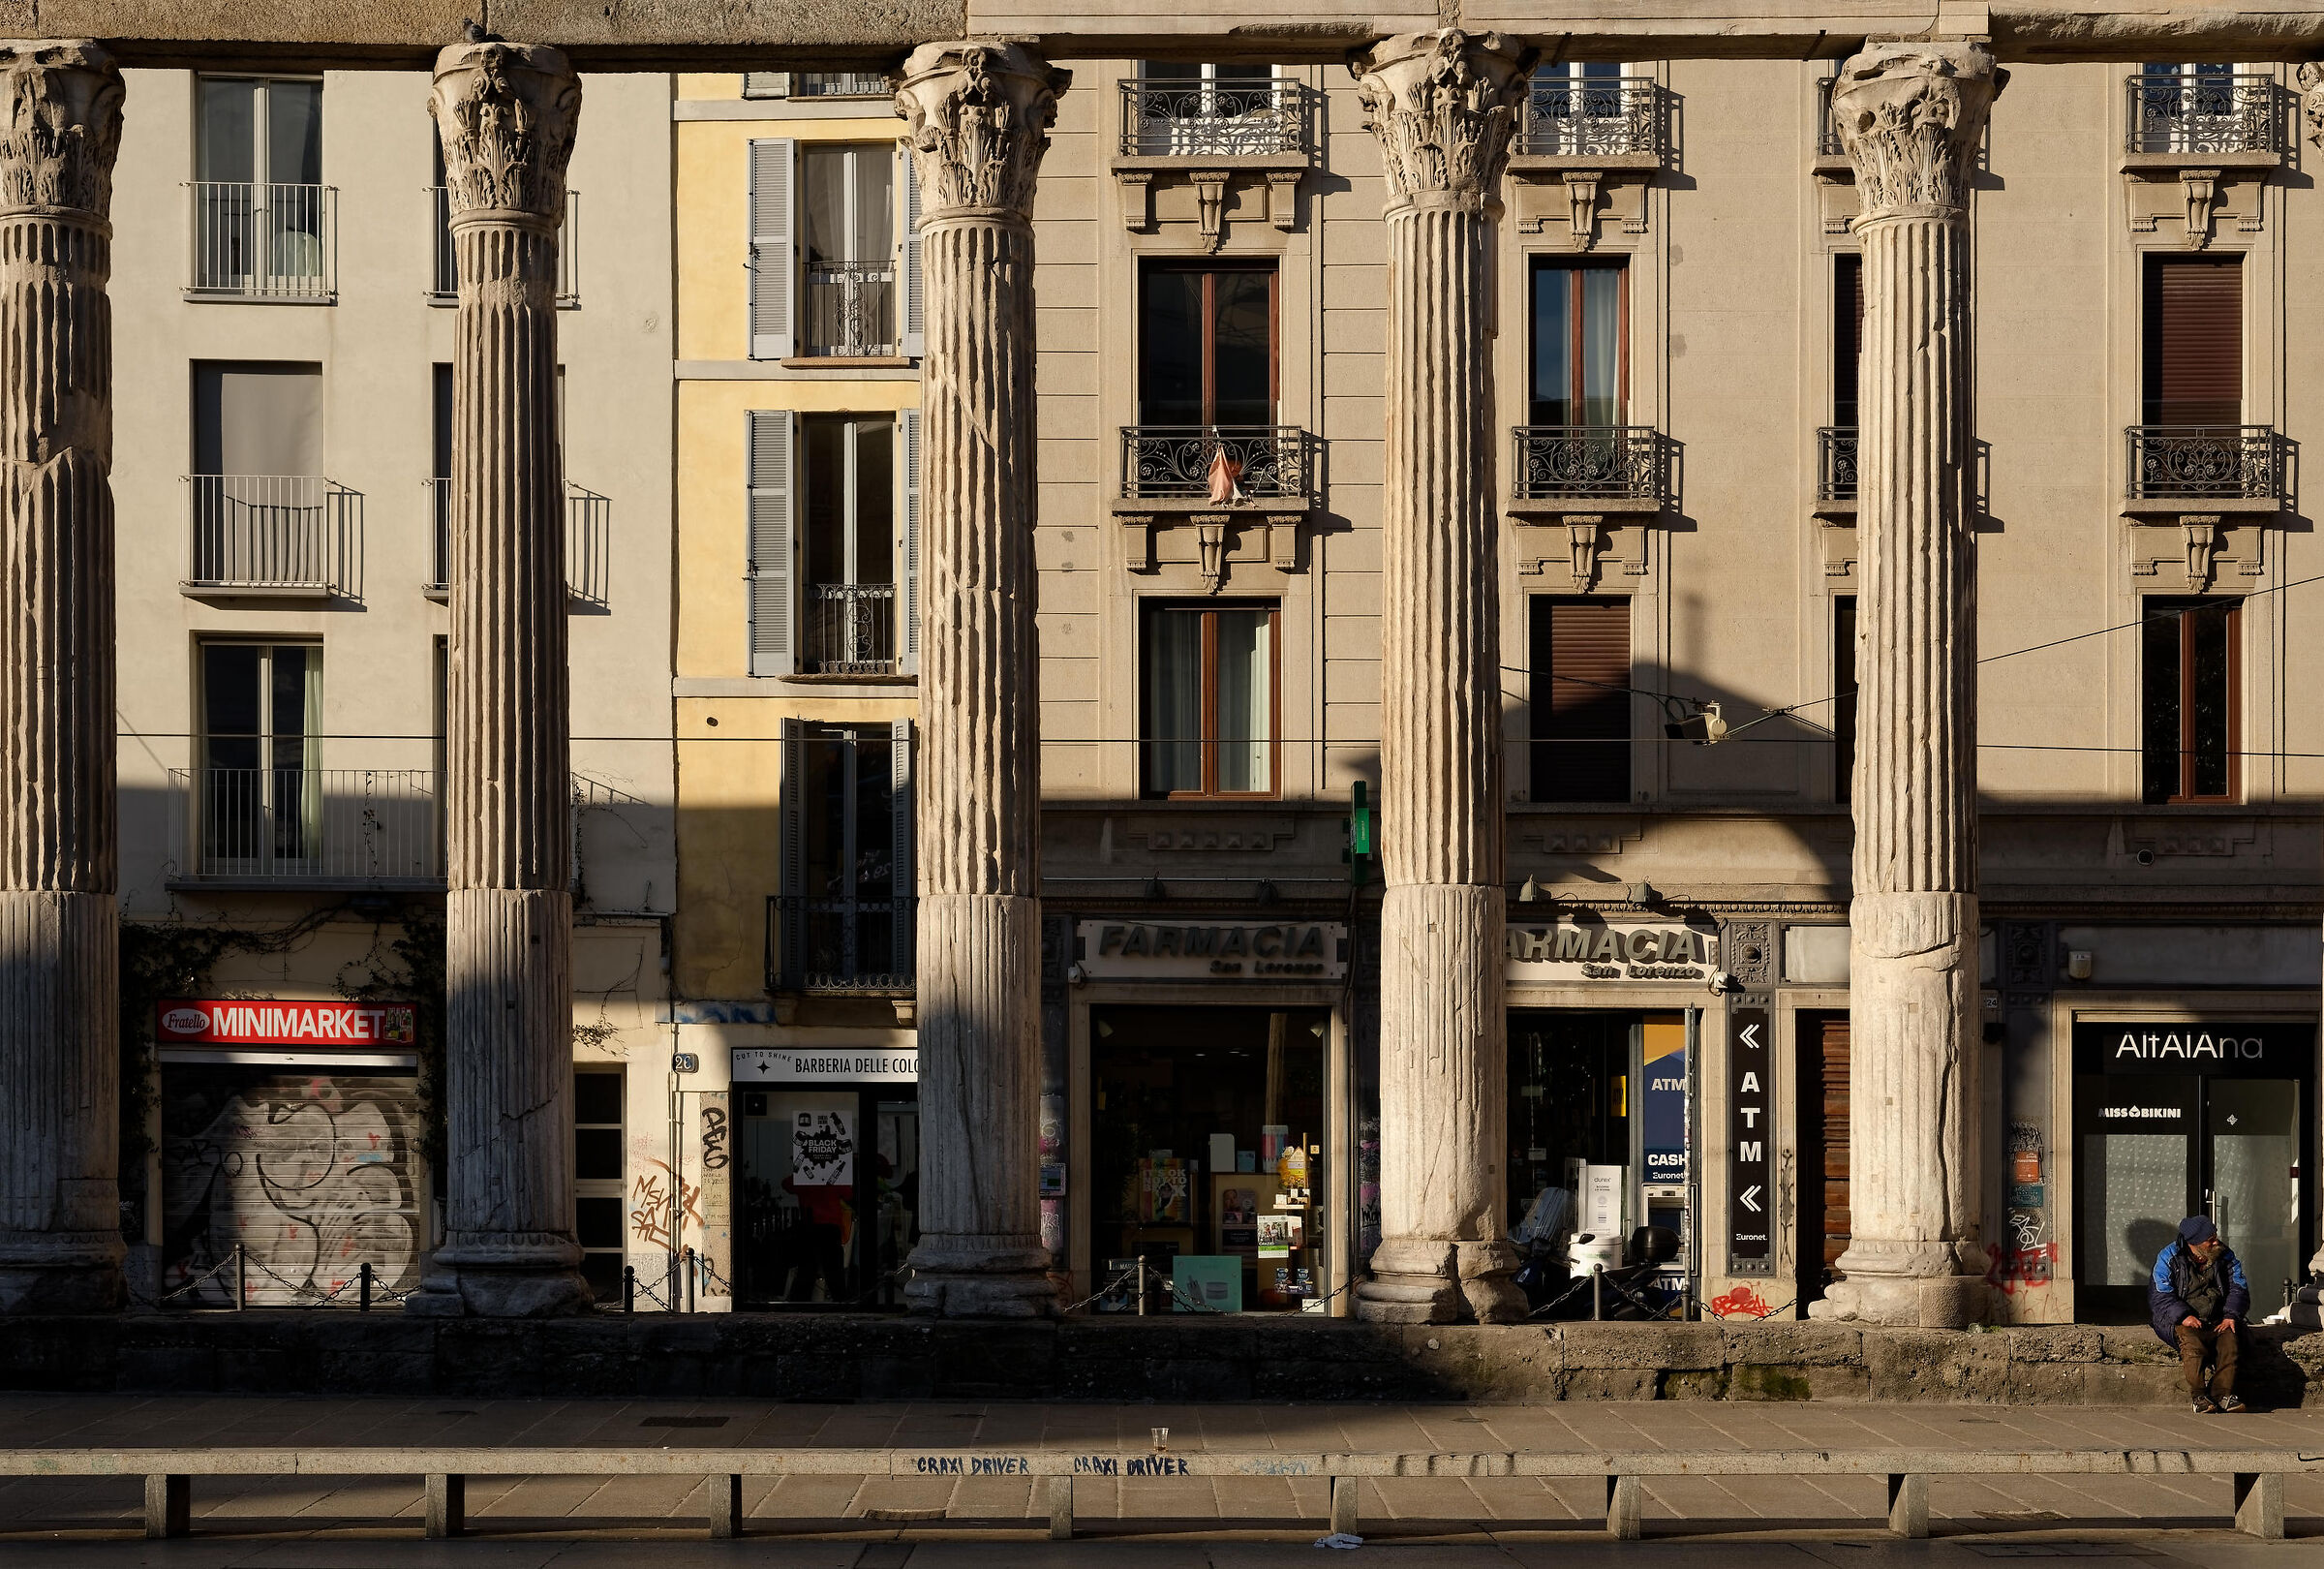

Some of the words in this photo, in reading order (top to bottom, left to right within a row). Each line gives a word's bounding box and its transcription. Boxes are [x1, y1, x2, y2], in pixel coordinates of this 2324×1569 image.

[1097, 925, 1325, 958] FARMACIA
[1209, 960, 1241, 974] San
[1580, 963, 1614, 976] San
[1626, 963, 1697, 977] Lorenzo
[167, 1013, 206, 1030] Fratello
[212, 1007, 386, 1039] MINIMARKET
[735, 1052, 751, 1061] CUT
[768, 1052, 793, 1062] SHINE
[795, 1058, 851, 1073] BARBERIA
[855, 1058, 889, 1073] DELLE
[1651, 1078, 1685, 1092] ATM
[1740, 1071, 1762, 1162] ATM
[2141, 1107, 2182, 1119] BIKINI
[1647, 1153, 1685, 1167] CASH
[1169, 1168, 1187, 1178] OK
[916, 1456, 964, 1475] CRAXI
[970, 1457, 1029, 1475] DRIVER
[1074, 1456, 1117, 1476] CRAXI
[1126, 1456, 1191, 1476] DRIVER
